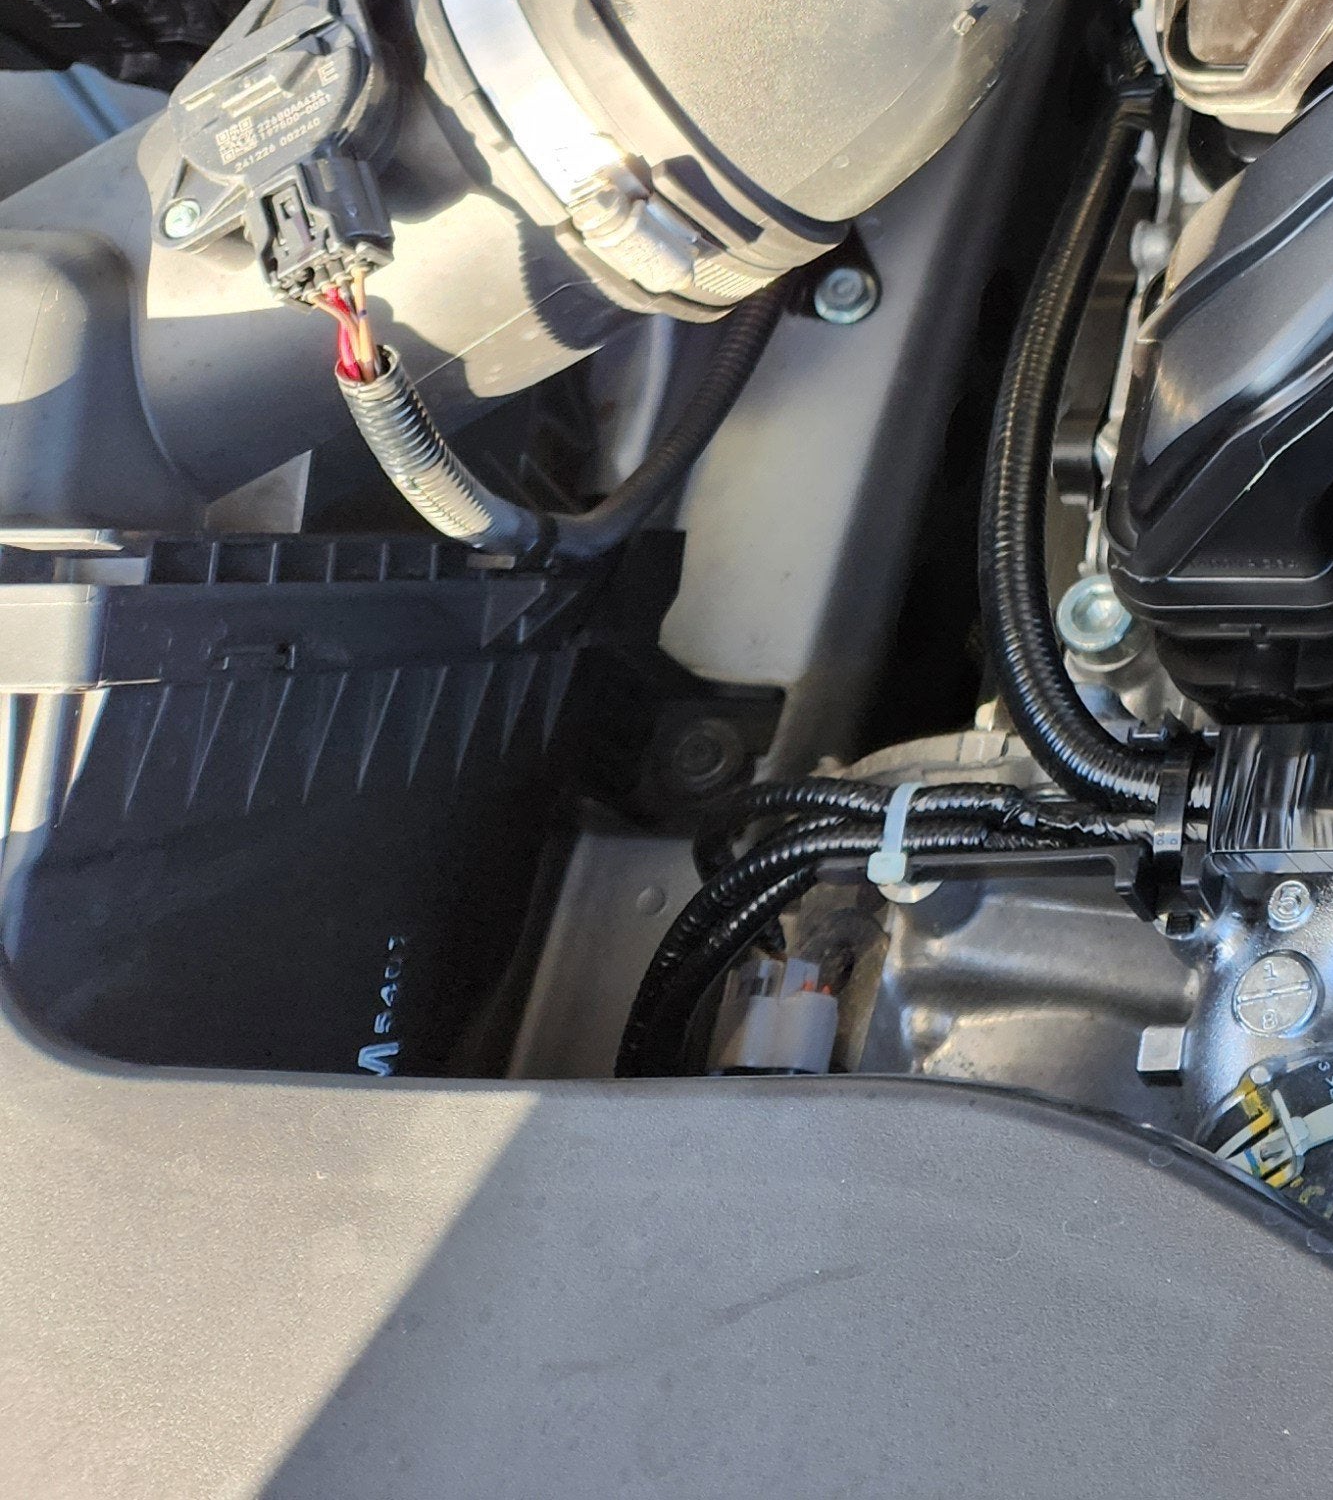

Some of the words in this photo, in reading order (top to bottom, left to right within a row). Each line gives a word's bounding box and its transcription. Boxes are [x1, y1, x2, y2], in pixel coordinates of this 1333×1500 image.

[317, 60, 340, 88] E
[1278, 885, 1302, 916] 5
[1263, 960, 1278, 980] 1
[1262, 1009, 1277, 1030] 8
